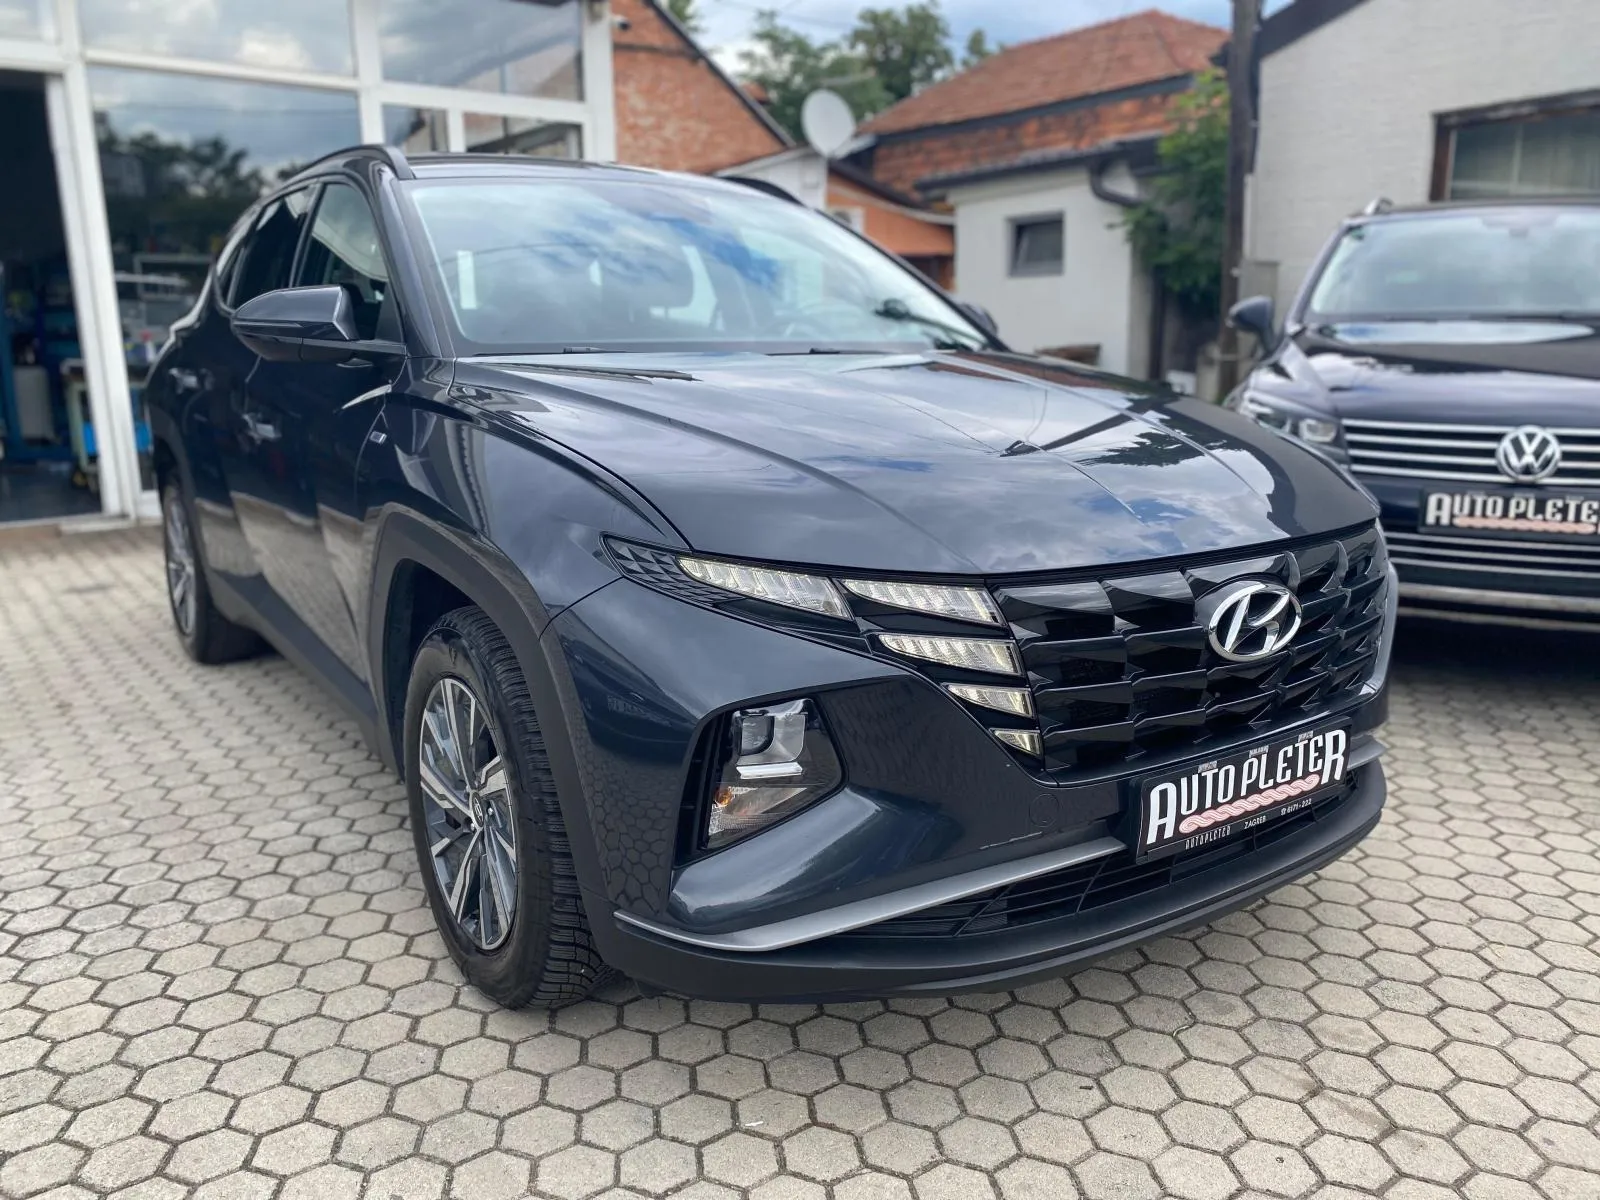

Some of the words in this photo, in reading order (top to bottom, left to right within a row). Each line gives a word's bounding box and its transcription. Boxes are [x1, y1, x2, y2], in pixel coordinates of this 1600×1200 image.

[1425, 492, 1504, 526] AUTO
[1508, 495, 1600, 535] PLETE
[1146, 764, 1235, 845] AUTO
[1240, 729, 1347, 797] PLETER
